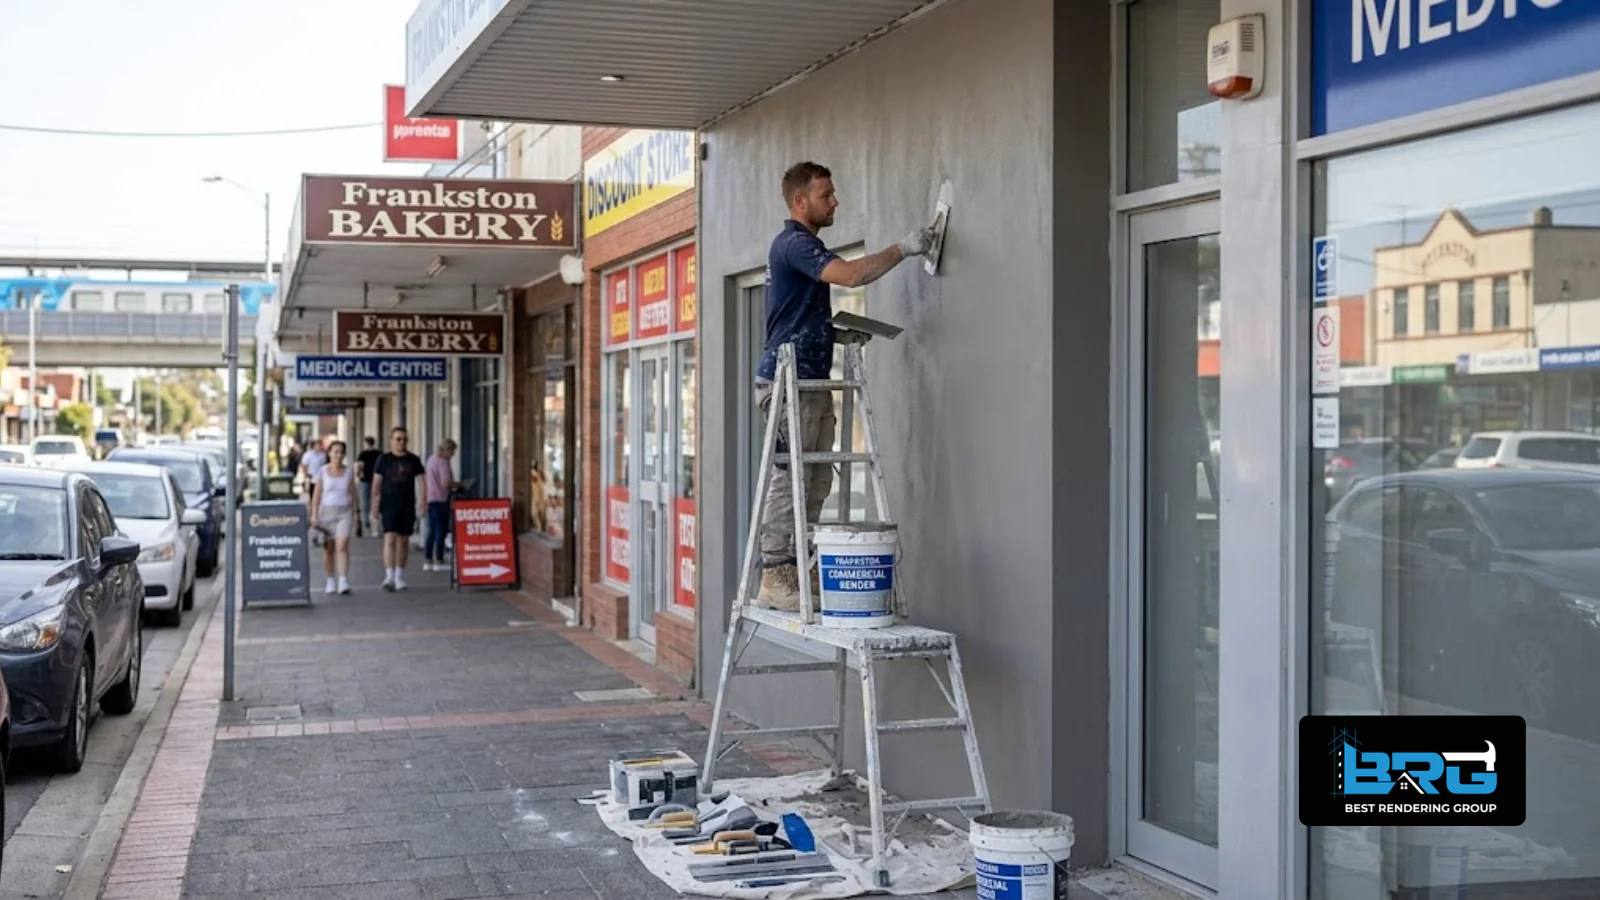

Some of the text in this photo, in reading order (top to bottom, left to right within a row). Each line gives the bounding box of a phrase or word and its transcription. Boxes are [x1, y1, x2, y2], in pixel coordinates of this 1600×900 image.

[588, 130, 690, 221] DISCOUNT STORE
[342, 182, 538, 209] Frankston
[328, 210, 548, 241] BAKERY
[362, 315, 473, 331] Frankston
[347, 331, 488, 351] BAKERY
[300, 360, 443, 377] MEDICAL CENTRE
[828, 569, 886, 579] COMMERCIAL
